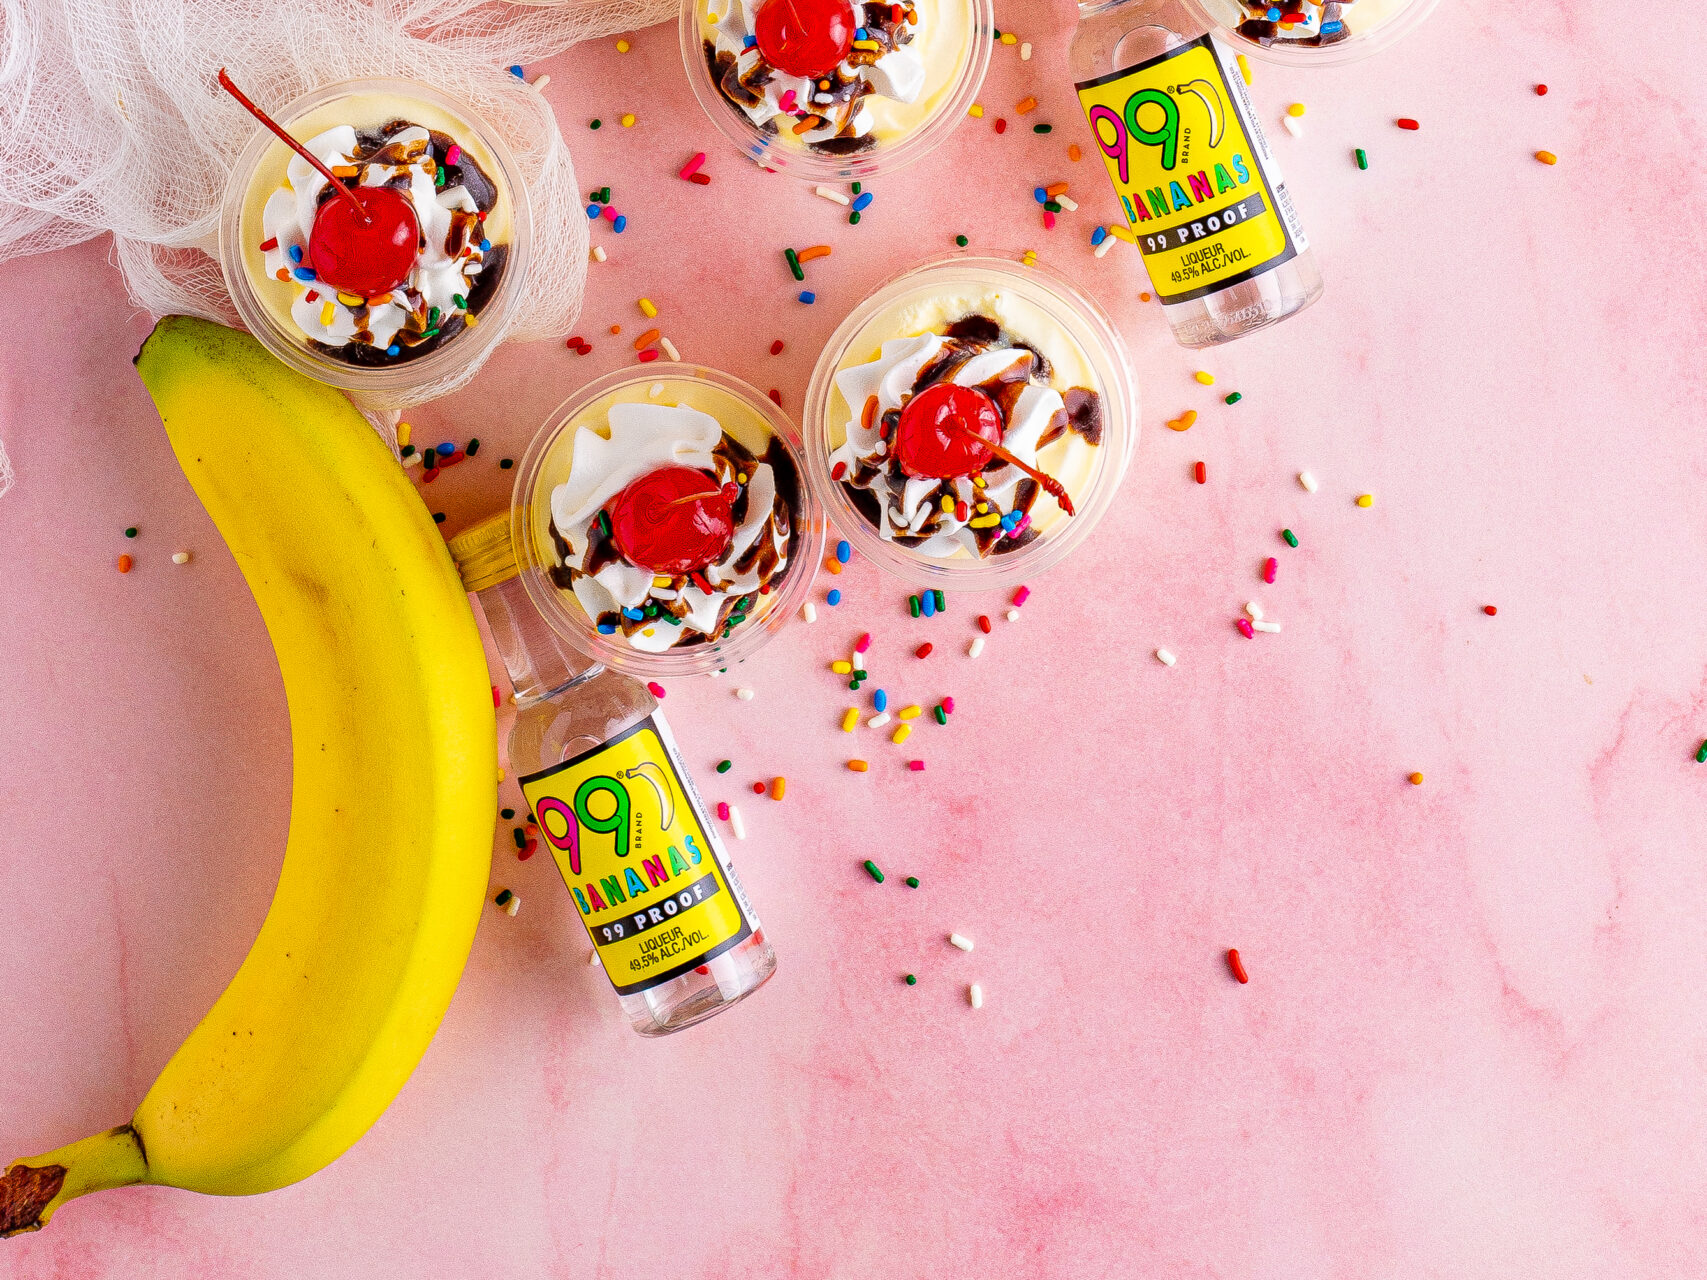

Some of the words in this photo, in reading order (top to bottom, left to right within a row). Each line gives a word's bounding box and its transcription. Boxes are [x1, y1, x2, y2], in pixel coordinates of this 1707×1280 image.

[1089, 88, 1180, 184] 99
[1181, 127, 1191, 164] BRAND
[1121, 154, 1249, 223] BANANAS
[1147, 234, 1167, 252] 99
[1176, 203, 1248, 243] PROOF
[1171, 266, 1200, 283] 49.5%
[1180, 242, 1225, 267] LIQUEUR
[536, 775, 631, 875] 99
[635, 812, 643, 849] BRAND
[572, 834, 702, 915] BANANAS
[602, 923, 624, 941] 99
[633, 884, 703, 930] PROOF
[639, 926, 684, 953] LIQUEUR
